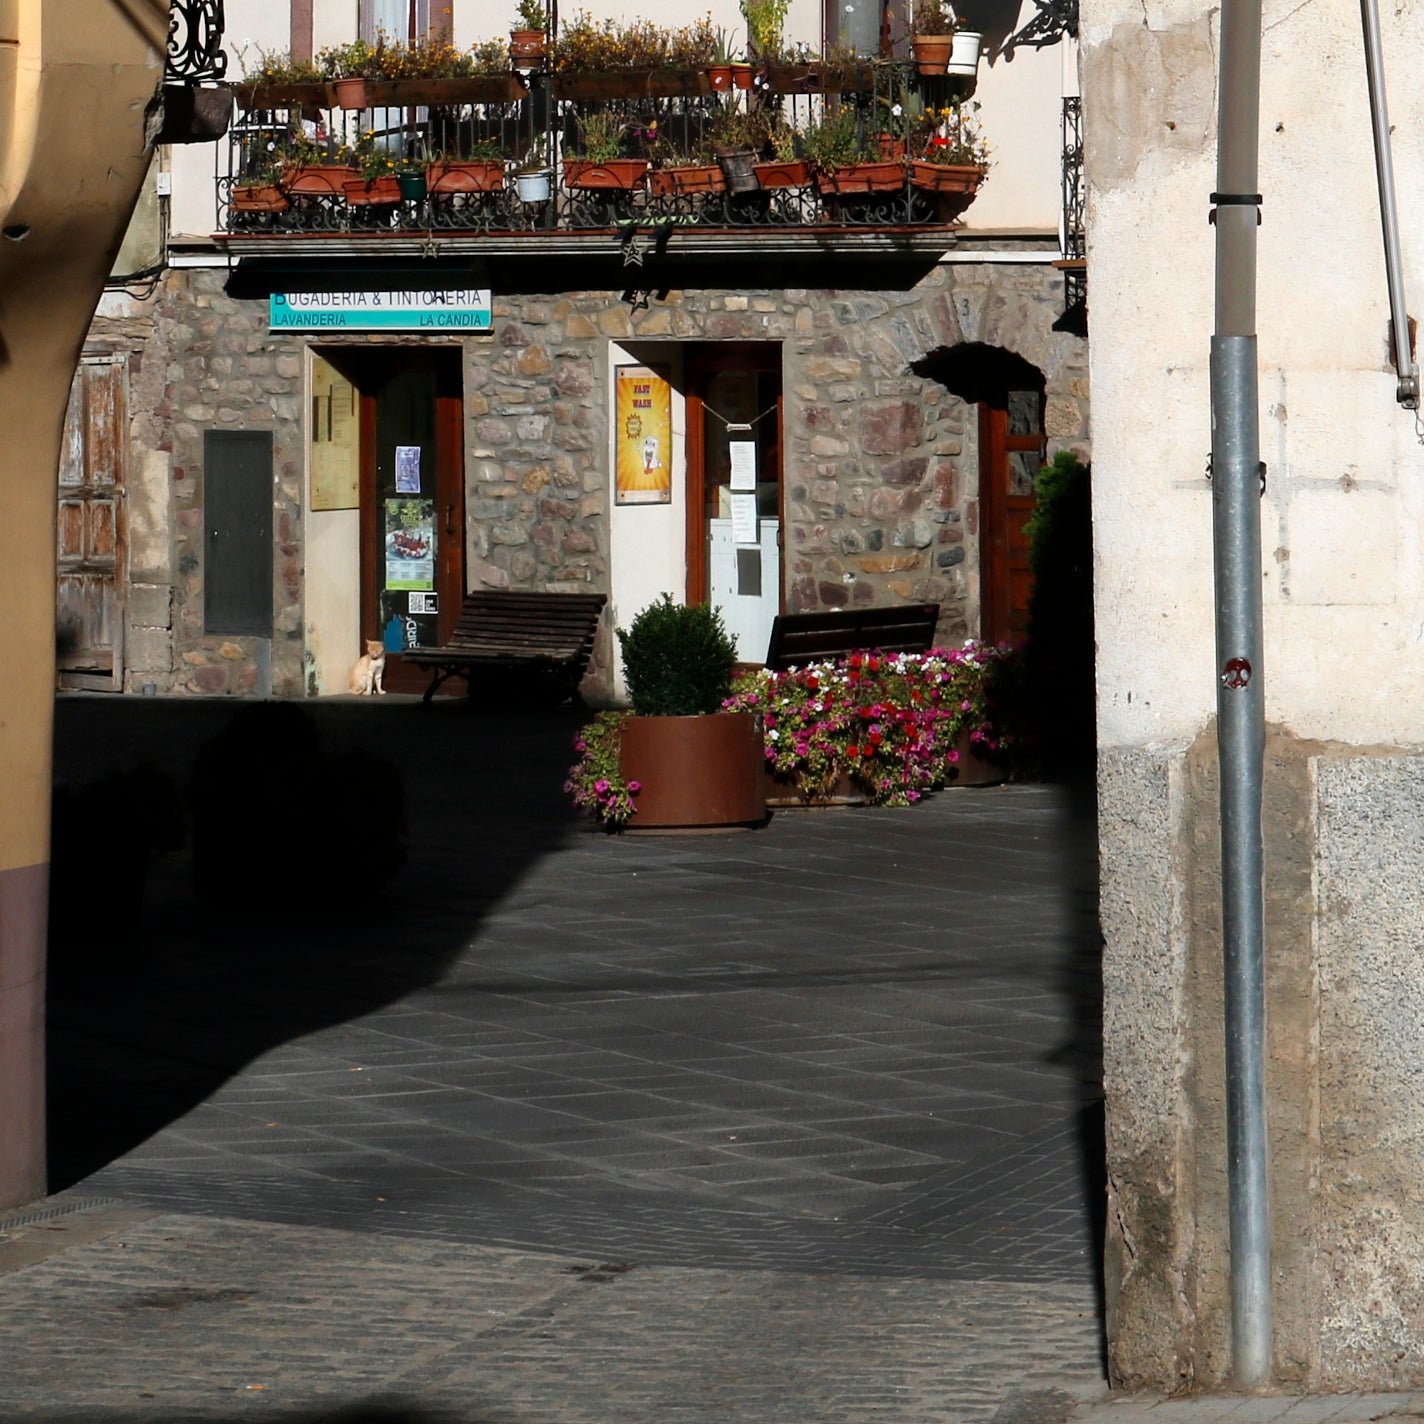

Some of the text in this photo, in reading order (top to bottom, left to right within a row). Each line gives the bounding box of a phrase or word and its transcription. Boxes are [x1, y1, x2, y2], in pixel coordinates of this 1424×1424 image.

[275, 293, 367, 306] BUGADERIA
[372, 291, 382, 305] &
[275, 314, 346, 326] LAVANDERIA
[420, 314, 482, 326] LA CANDIA
[633, 385, 651, 394] FAST
[632, 399, 652, 408] WASH
